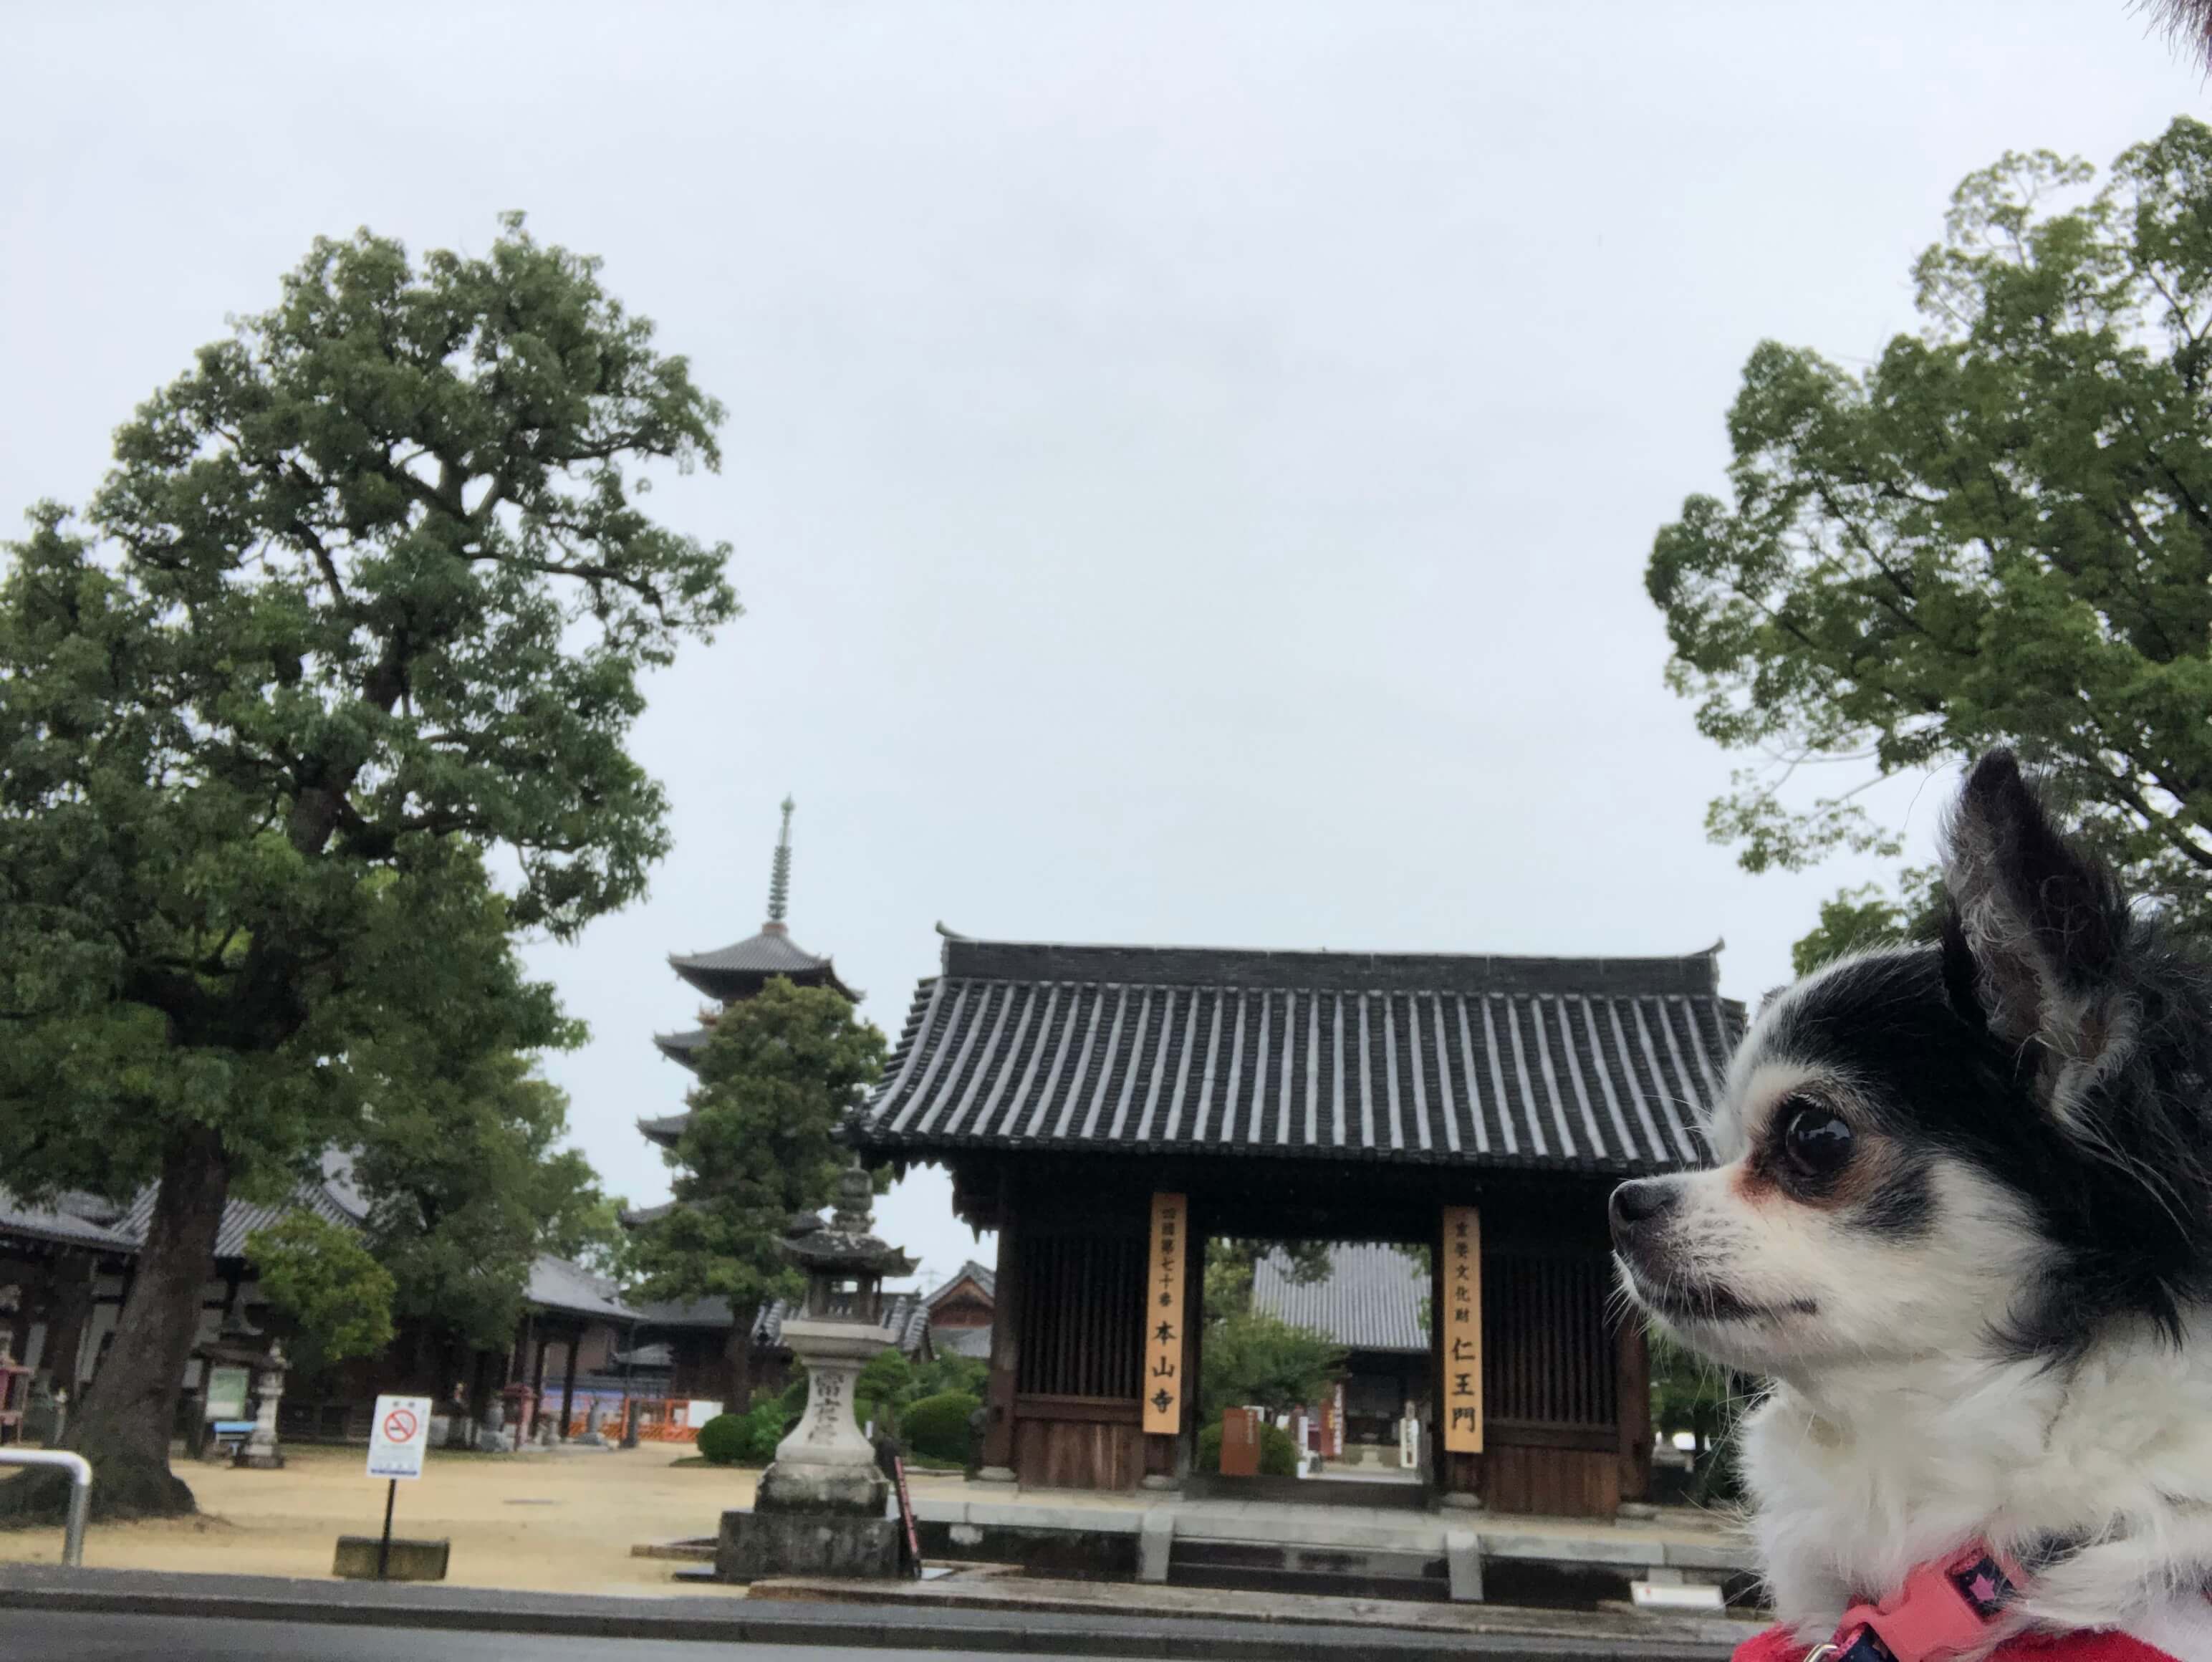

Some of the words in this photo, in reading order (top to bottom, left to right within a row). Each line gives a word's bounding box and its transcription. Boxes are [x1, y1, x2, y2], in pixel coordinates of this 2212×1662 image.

[1150, 1320, 1176, 1414] 本山寺
[1451, 1336, 1476, 1433] 仁王門
